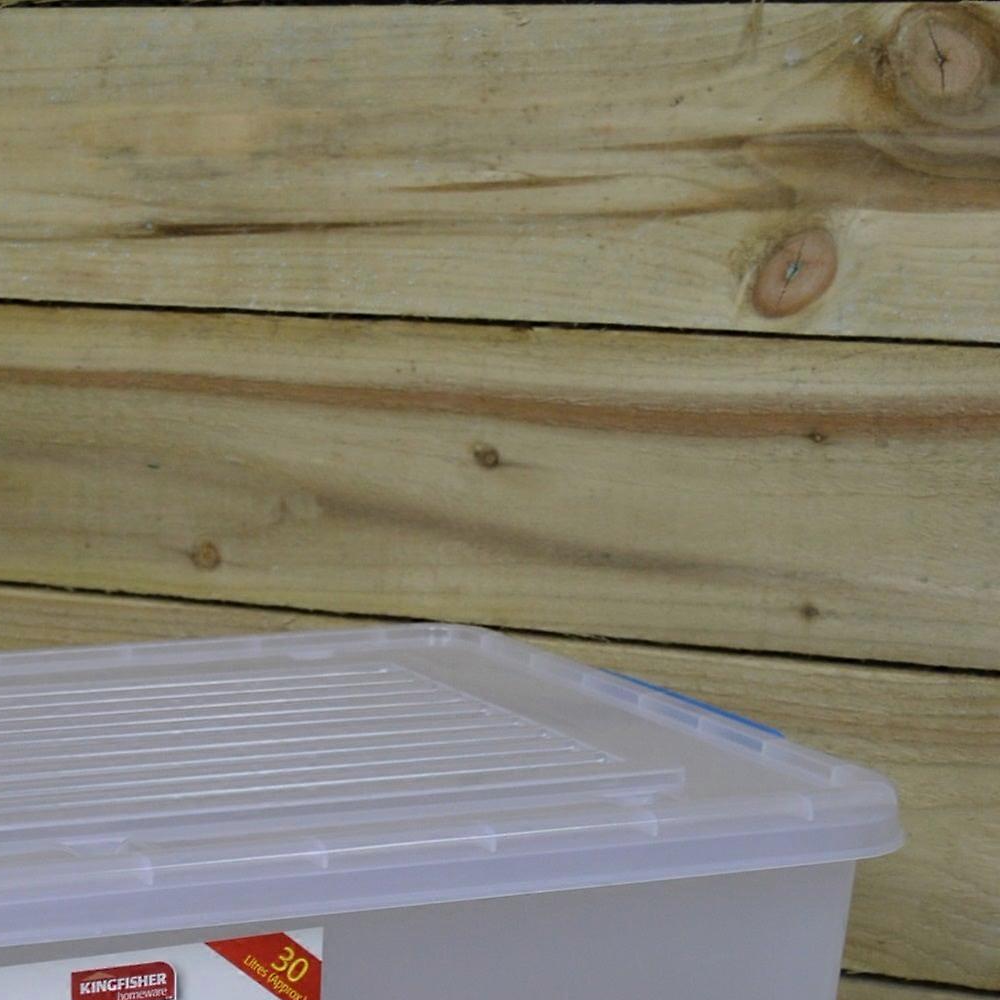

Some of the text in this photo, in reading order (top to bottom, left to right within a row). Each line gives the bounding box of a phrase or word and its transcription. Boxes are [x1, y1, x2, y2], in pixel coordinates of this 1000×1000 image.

[243, 955, 268, 977] Litres
[270, 946, 309, 982] 30
[80, 972, 168, 995] KINGFISHER
[117, 987, 168, 1000] homeware
